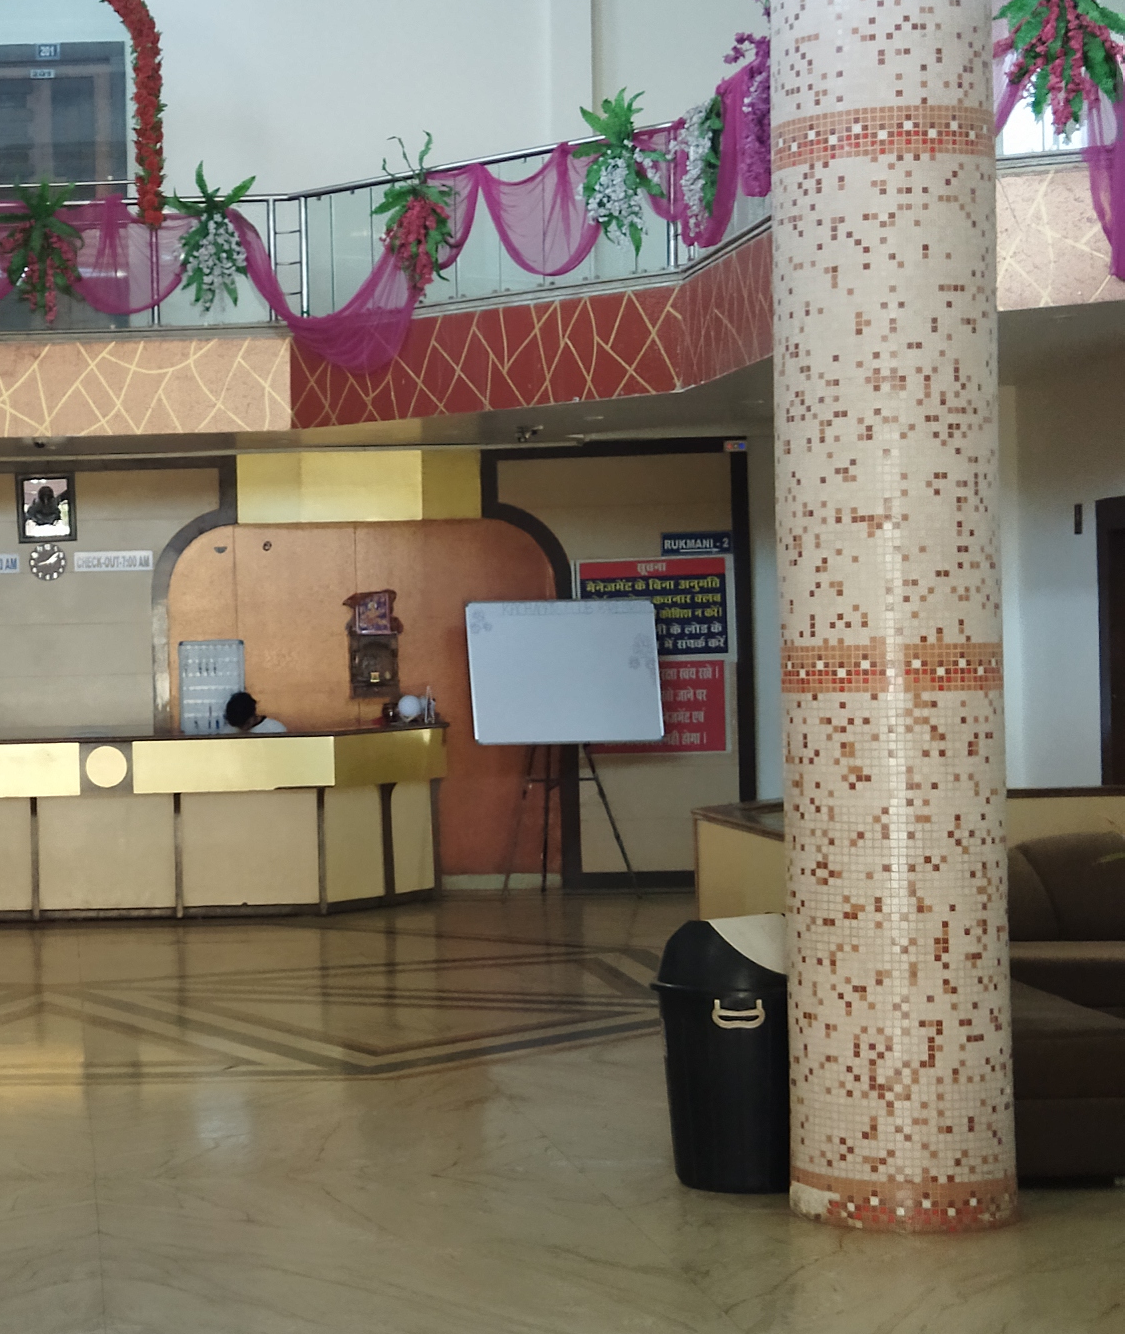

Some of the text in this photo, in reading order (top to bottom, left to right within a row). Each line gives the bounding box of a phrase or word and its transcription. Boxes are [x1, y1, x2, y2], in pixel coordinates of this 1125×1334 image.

[664, 538, 713, 550] RUKMANI
[722, 537, 729, 548] 2
[5, 558, 17, 570] AM
[138, 555, 150, 568] AM
[637, 562, 666, 576] सूचना
[635, 580, 646, 591] के
[649, 578, 674, 590] बिना
[679, 576, 720, 592] अनुमति
[652, 594, 691, 604] कचनार
[695, 609, 702, 617] न
[670, 623, 681, 634] के
[684, 622, 708, 634] लोड
[711, 621, 722, 633] के
[677, 636, 706, 649] संपर्क
[707, 635, 725, 647] करें
[696, 689, 707, 701] पर
